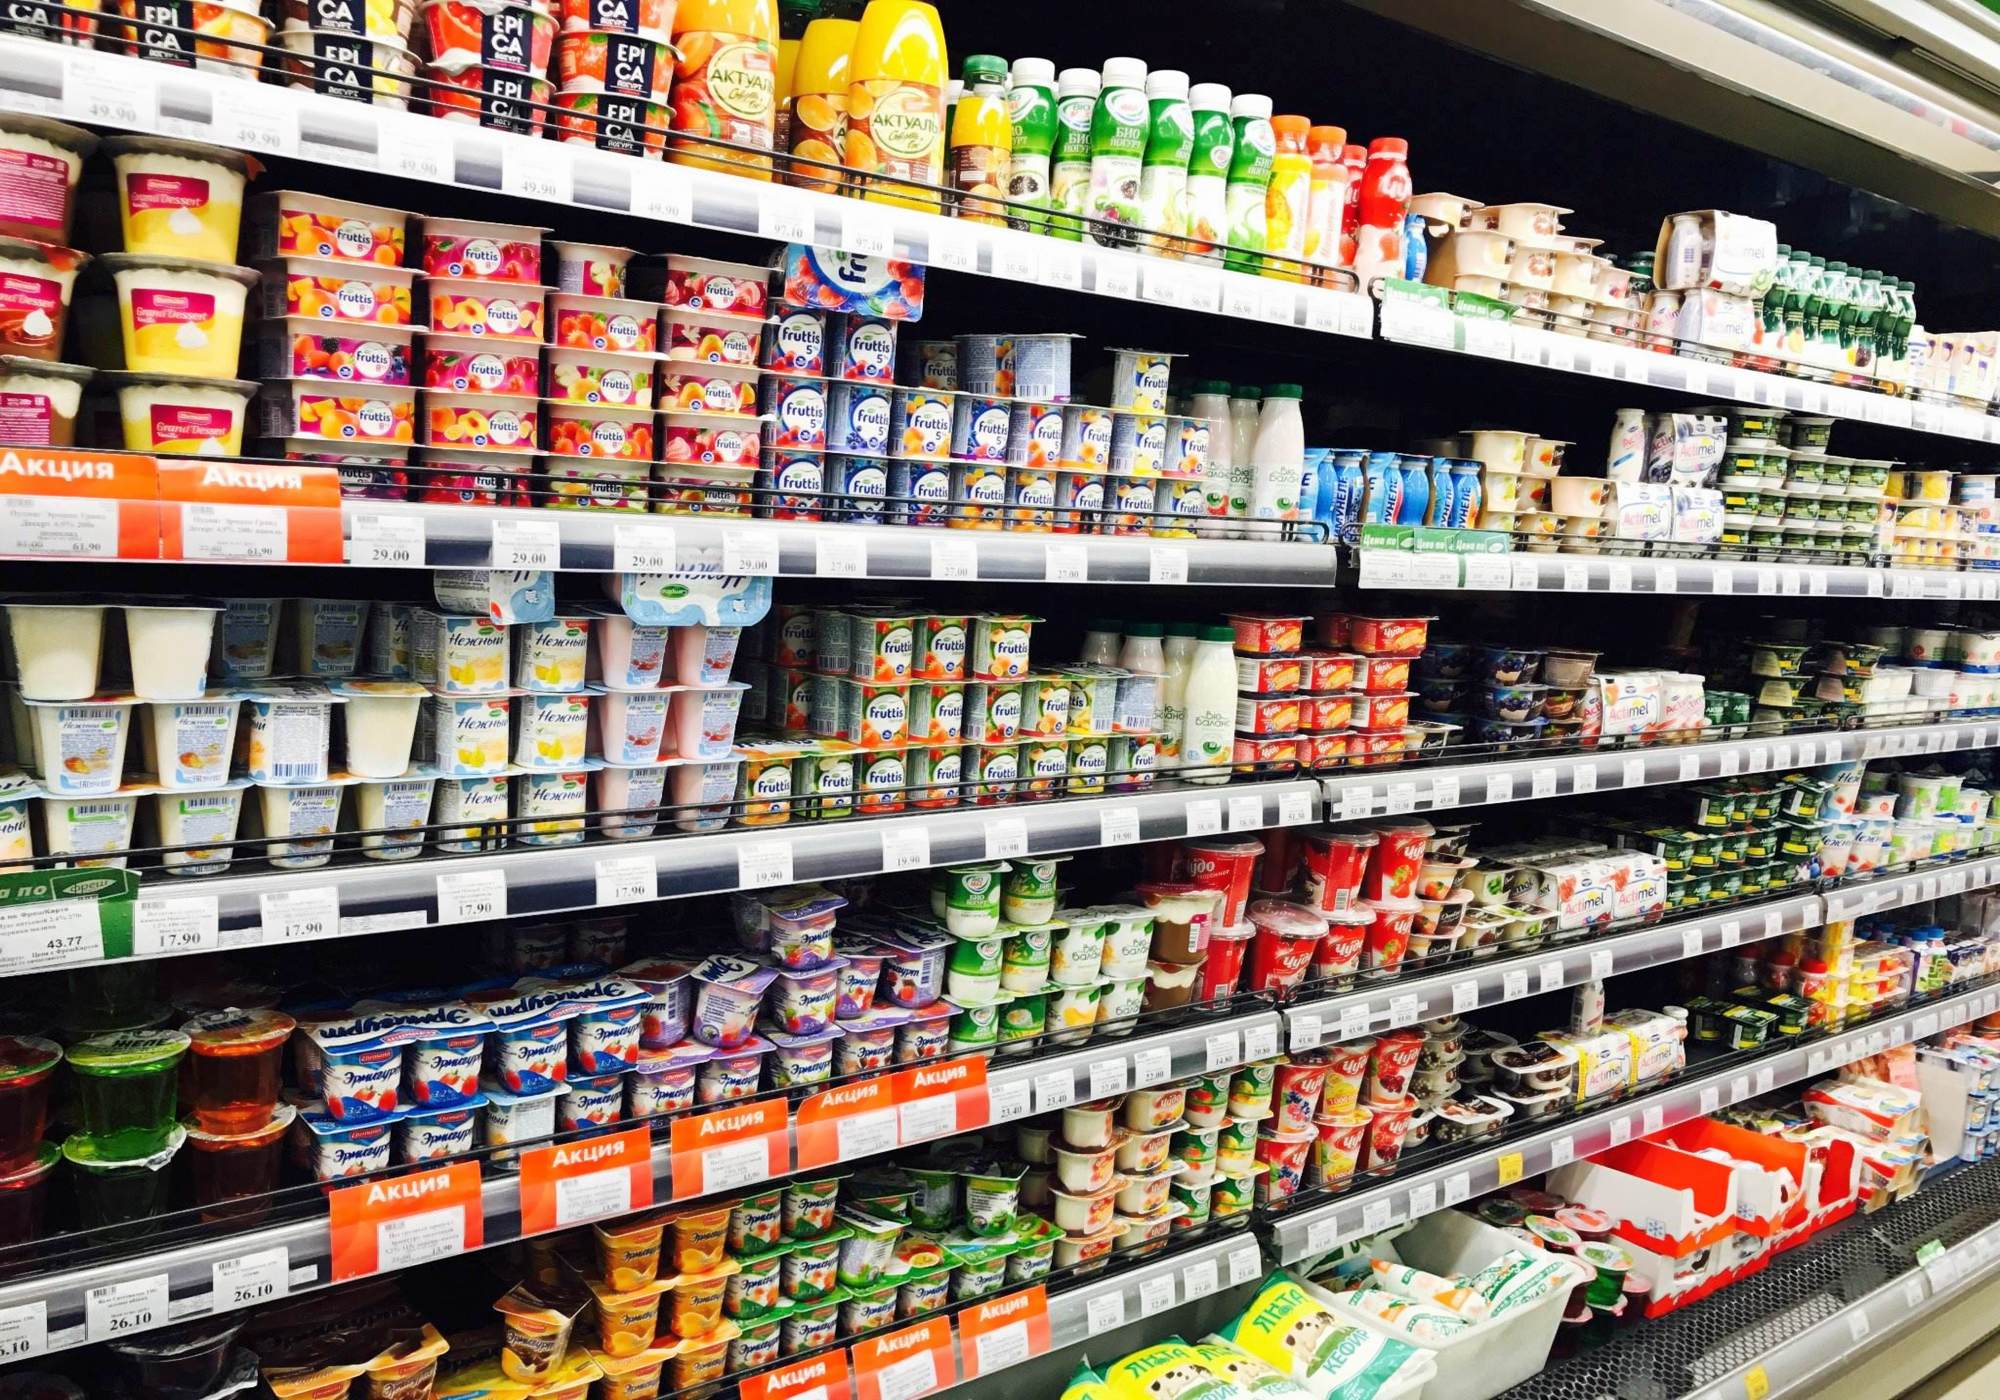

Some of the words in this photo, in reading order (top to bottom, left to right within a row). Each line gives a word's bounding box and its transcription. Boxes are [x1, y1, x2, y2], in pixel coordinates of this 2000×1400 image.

[493, 15, 523, 35] EPI
[145, 29, 181, 50] CA
[491, 34, 523, 56] CA
[617, 43, 646, 65] EPI
[323, 66, 358, 86] CA
[614, 63, 644, 84] CA
[237, 129, 281, 149] 49.90
[521, 180, 557, 197] 49.90
[1, 451, 114, 482] Акция
[203, 465, 303, 492] Акция
[1623, 509, 1662, 526] Actimel
[1675, 513, 1715, 530] Actimel
[373, 549, 410, 562] 29.00
[512, 552, 546, 565] 29.00
[632, 555, 664, 569] 29.00
[739, 559, 769, 572] 29.00
[944, 564, 969, 578] 27.00
[1057, 568, 1080, 581] 27.00
[1160, 570, 1181, 583] 27.00
[448, 632, 504, 647] Нежный
[536, 632, 588, 648] Нежный
[1384, 625, 1405, 640] Чудо
[538, 708, 588, 725] Нежный
[1609, 703, 1650, 721] Actimel
[533, 788, 585, 804] Нежный
[755, 870, 784, 882] 19.90
[17, 886, 48, 897] по
[614, 884, 645, 898] 17.90
[1618, 886, 1658, 904] Actimel
[458, 902, 492, 916] 17.90
[1565, 895, 1606, 915] Actimel
[284, 921, 323, 937] 17.90
[47, 936, 82, 949] 43.77
[159, 932, 201, 947] 17.90
[344, 1066, 401, 1087] Эрмигур
[914, 1064, 967, 1088] Акция
[1587, 1064, 1623, 1085] Actimel
[821, 1082, 879, 1109] Акция
[700, 1109, 764, 1138] Акция
[553, 1140, 625, 1169] Акция
[367, 1171, 451, 1205] Акция
[234, 1283, 273, 1302] 26.10
[980, 1294, 1029, 1323] Акция
[110, 1311, 152, 1332] 26.10
[876, 1326, 930, 1357] Акция
[1323, 1326, 1370, 1376] КЕФИР
[766, 1361, 826, 1394] Акция
